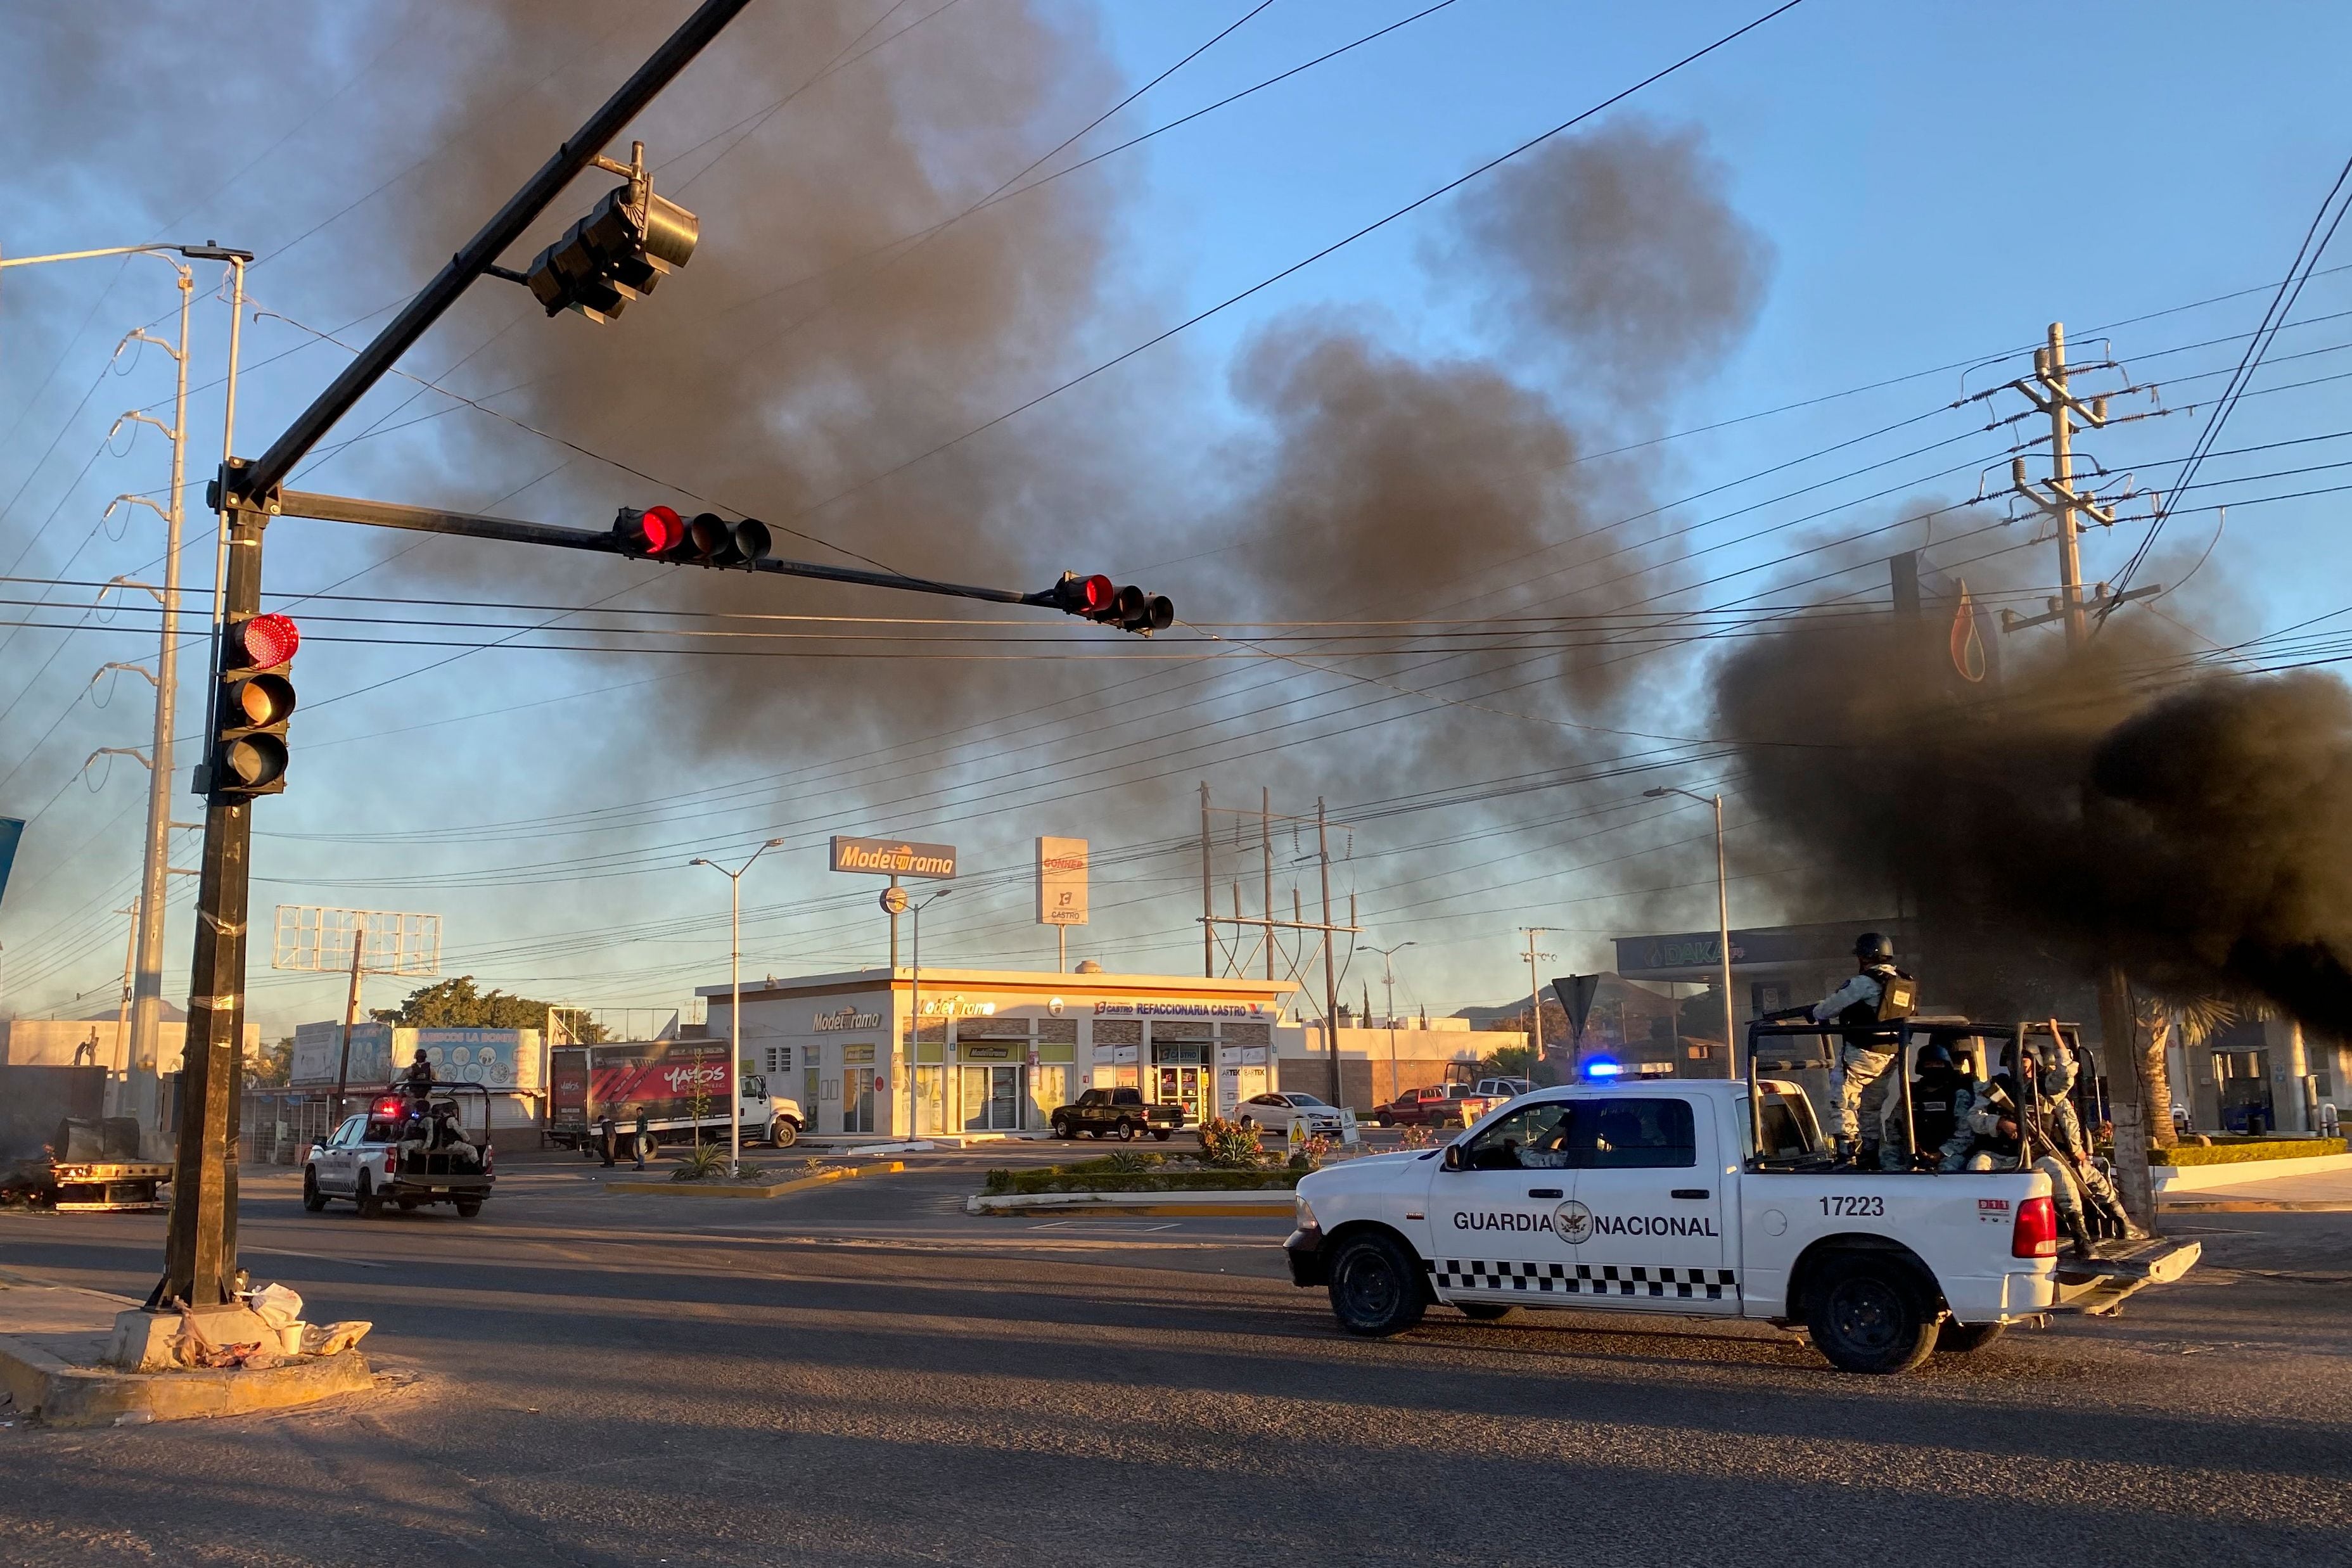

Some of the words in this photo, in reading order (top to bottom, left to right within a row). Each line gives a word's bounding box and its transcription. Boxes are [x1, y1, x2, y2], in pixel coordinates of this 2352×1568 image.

[1052, 911, 1080, 919] CASTRO
[1107, 1005, 1134, 1013] CASTRO
[1136, 1002, 1209, 1016] REFACCIONARIA
[1211, 1005, 1246, 1017] CASTRO
[466, 1032, 480, 1043] LA
[481, 1032, 520, 1043] BONITA
[1170, 1050, 1196, 1059] CASTRO
[1820, 1196, 1884, 1216] 17223
[1980, 1200, 2008, 1209] 911
[1454, 1211, 1554, 1233] GUARDIA
[1594, 1215, 1719, 1237] NACIONAL
